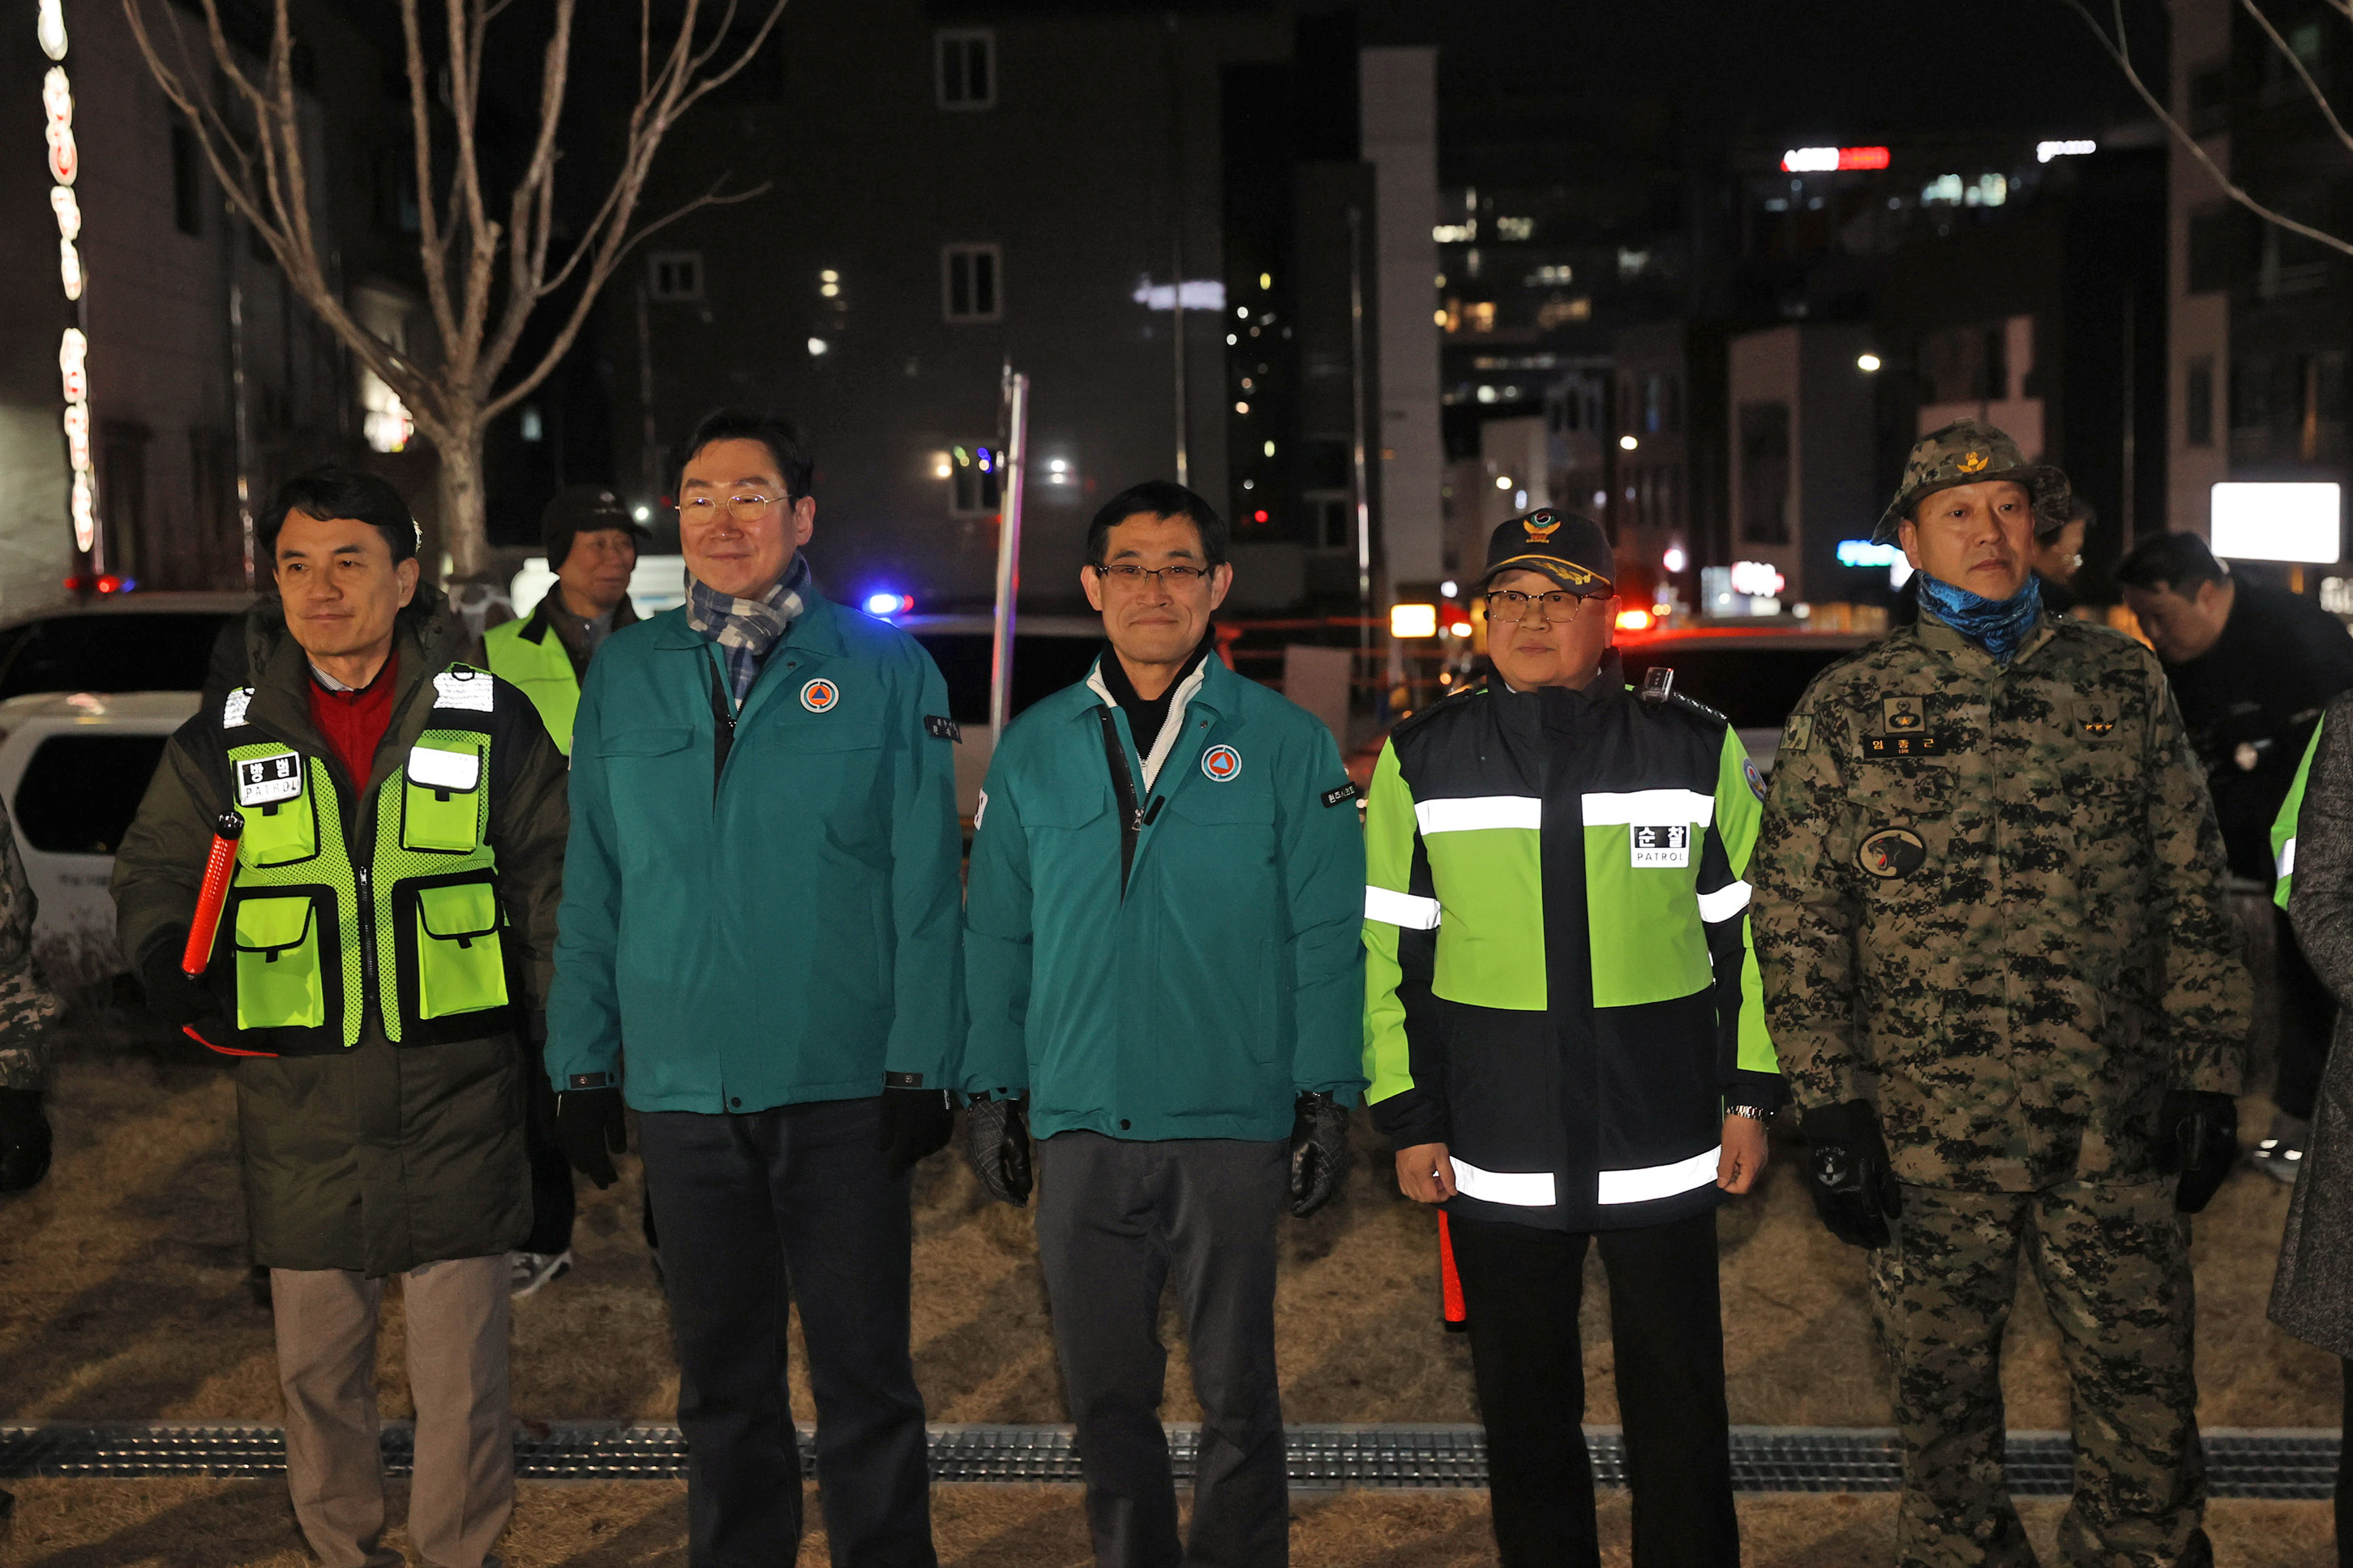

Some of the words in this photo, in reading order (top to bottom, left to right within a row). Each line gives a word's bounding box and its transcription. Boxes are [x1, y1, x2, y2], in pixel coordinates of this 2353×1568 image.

[246, 780, 296, 799] PATROL
[1638, 826, 1684, 848] 순찰
[1637, 852, 1683, 861] PATROL
